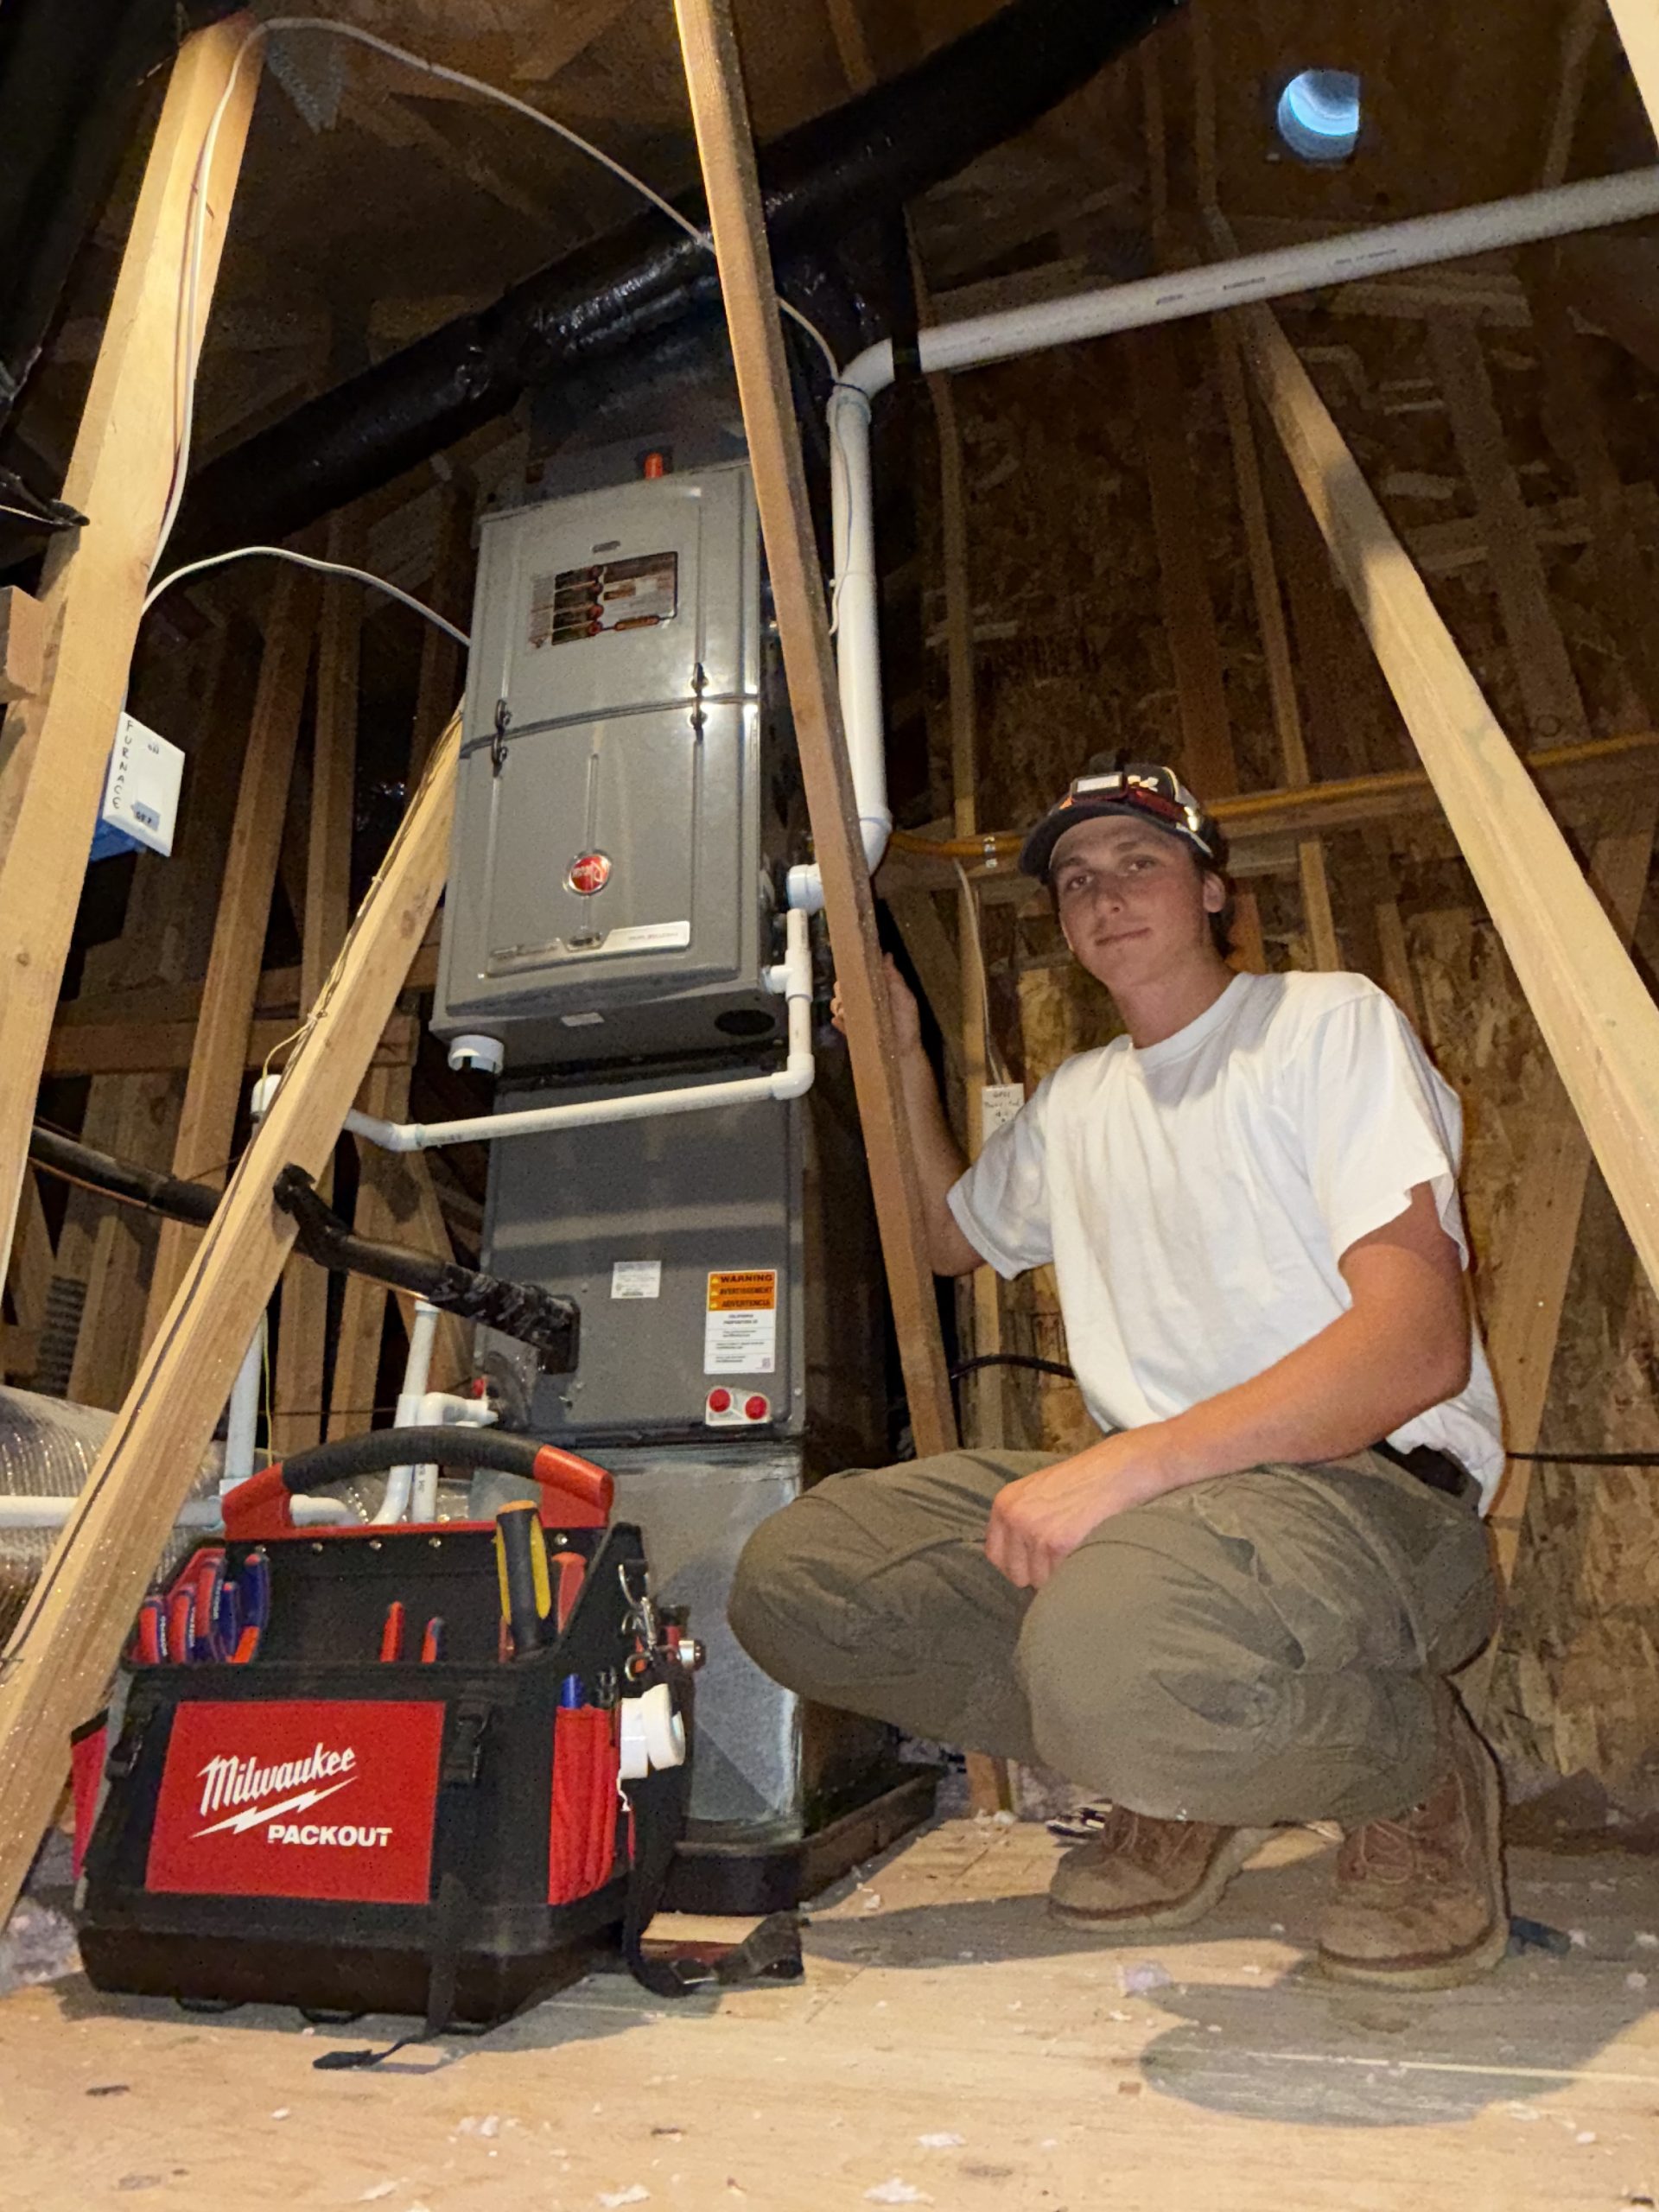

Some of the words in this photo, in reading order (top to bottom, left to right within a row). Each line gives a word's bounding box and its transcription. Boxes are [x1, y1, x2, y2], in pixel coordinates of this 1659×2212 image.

[112, 720, 133, 810] FURNACE
[721, 1274, 773, 1283] WARNING
[196, 1741, 357, 1817] Milwaukee
[267, 1825, 393, 1847] PACKOUT
